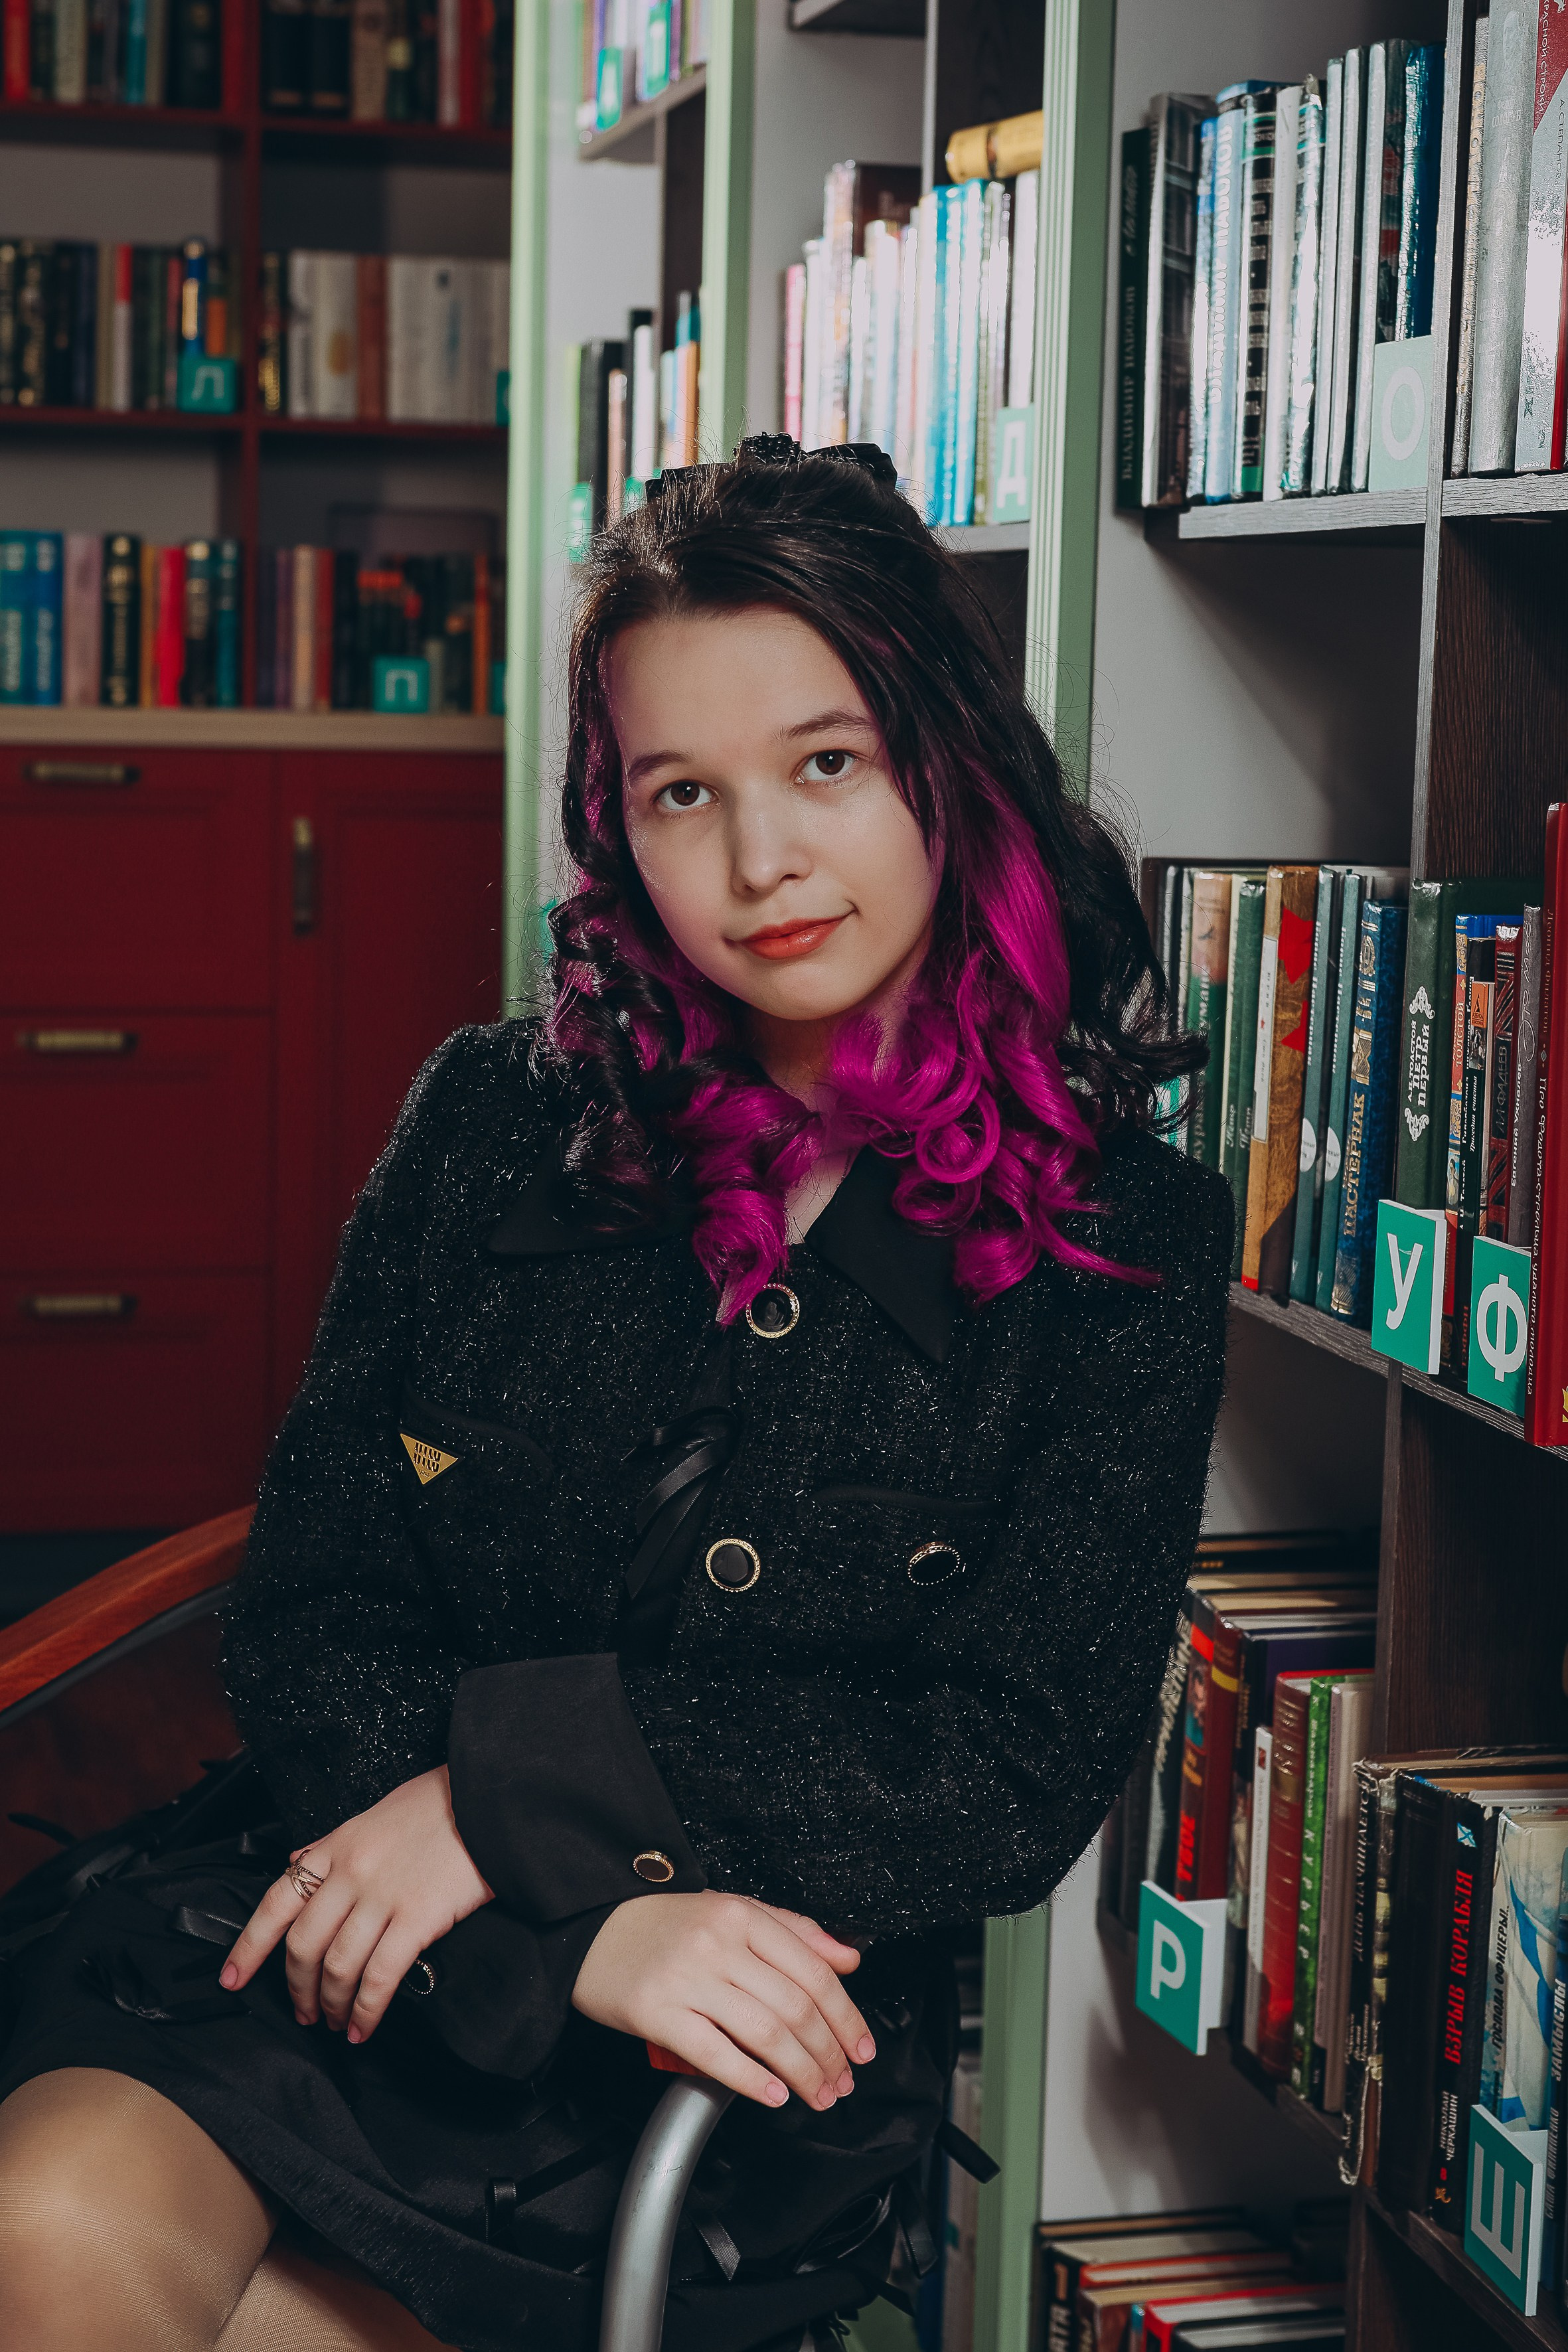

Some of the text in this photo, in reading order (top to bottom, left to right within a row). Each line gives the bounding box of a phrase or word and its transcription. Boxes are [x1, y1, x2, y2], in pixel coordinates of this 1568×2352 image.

[1537, 60, 1548, 112] СТРОКИ
[1216, 124, 1233, 247] НАБОКОВ
[1121, 285, 1136, 480] ВЛАДИМИР НАБОКОВ
[1380, 365, 1426, 461] О
[996, 422, 1028, 506] Д
[1543, 909, 1554, 1034] Леонид Филатов
[1456, 1002, 1464, 1067] ТОЛСТОЙ
[1497, 1046, 1509, 1106] ФАДЕЕВ
[1538, 1077, 1547, 1109] Про
[1344, 1092, 1365, 1237] ПАСТЕРНАК
[1385, 1232, 1423, 1330] У
[1476, 1273, 1528, 1383] Ф
[1528, 1263, 1538, 1324] удалого
[1527, 1327, 1536, 1395] молодца
[1298, 1828, 1315, 1960] КУРЬЕР
[1352, 1912, 1365, 1962] ДЕНЬ
[1150, 1919, 1186, 1999] Р
[1444, 1869, 1474, 2065] ВЗРЫВ КОРАБЛЯ
[1491, 1987, 1504, 2050] ГОСПОДА
[1550, 1978, 1567, 2082] ЗАМЫСЛЫ
[1445, 2094, 1458, 2161] ЧЕРКАШИН
[1545, 2106, 1560, 2219] САША ФИЛИПЕНКО
[1470, 2141, 1526, 2280] Ш
